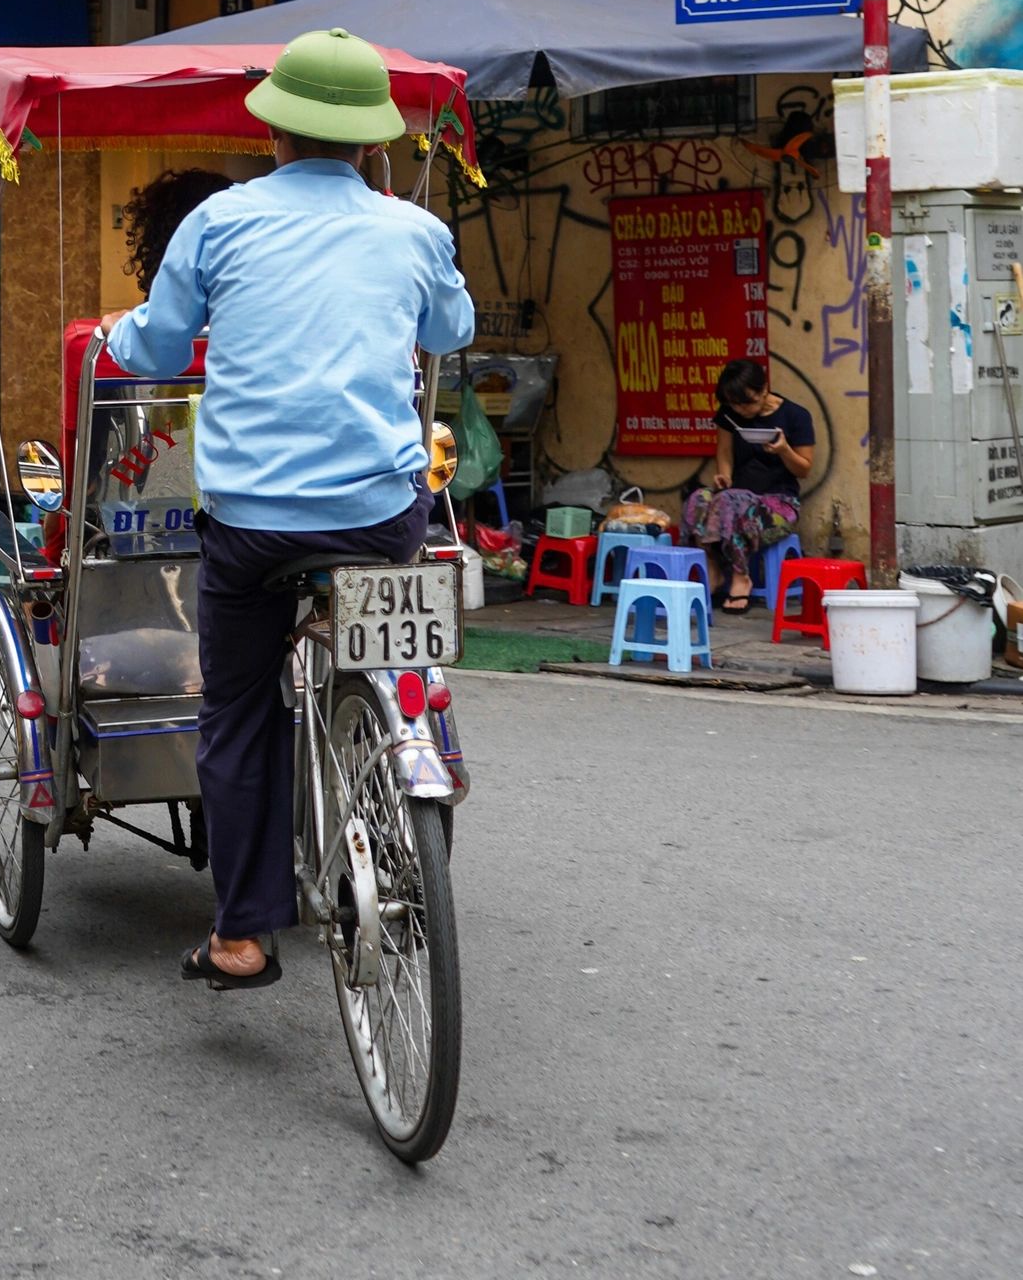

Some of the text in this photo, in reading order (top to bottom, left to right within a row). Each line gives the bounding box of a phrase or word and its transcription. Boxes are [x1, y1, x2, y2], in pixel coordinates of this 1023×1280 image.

[614, 206, 658, 241] CHÁO
[659, 203, 694, 243] ĐẬU
[697, 201, 721, 237] CÀ
[644, 246, 657, 256] 51
[687, 243, 710, 253] DUY
[644, 258, 651, 268] 5
[662, 281, 685, 307] ĐẬU
[743, 282, 764, 302] 15K
[745, 309, 765, 330] 17K
[618, 299, 660, 393] CHÁO
[746, 337, 766, 357] 22K
[626, 416, 639, 430] CÓ
[111, 421, 178, 488] HUY
[360, 574, 434, 617] 29XL
[348, 620, 444, 661] 0136
